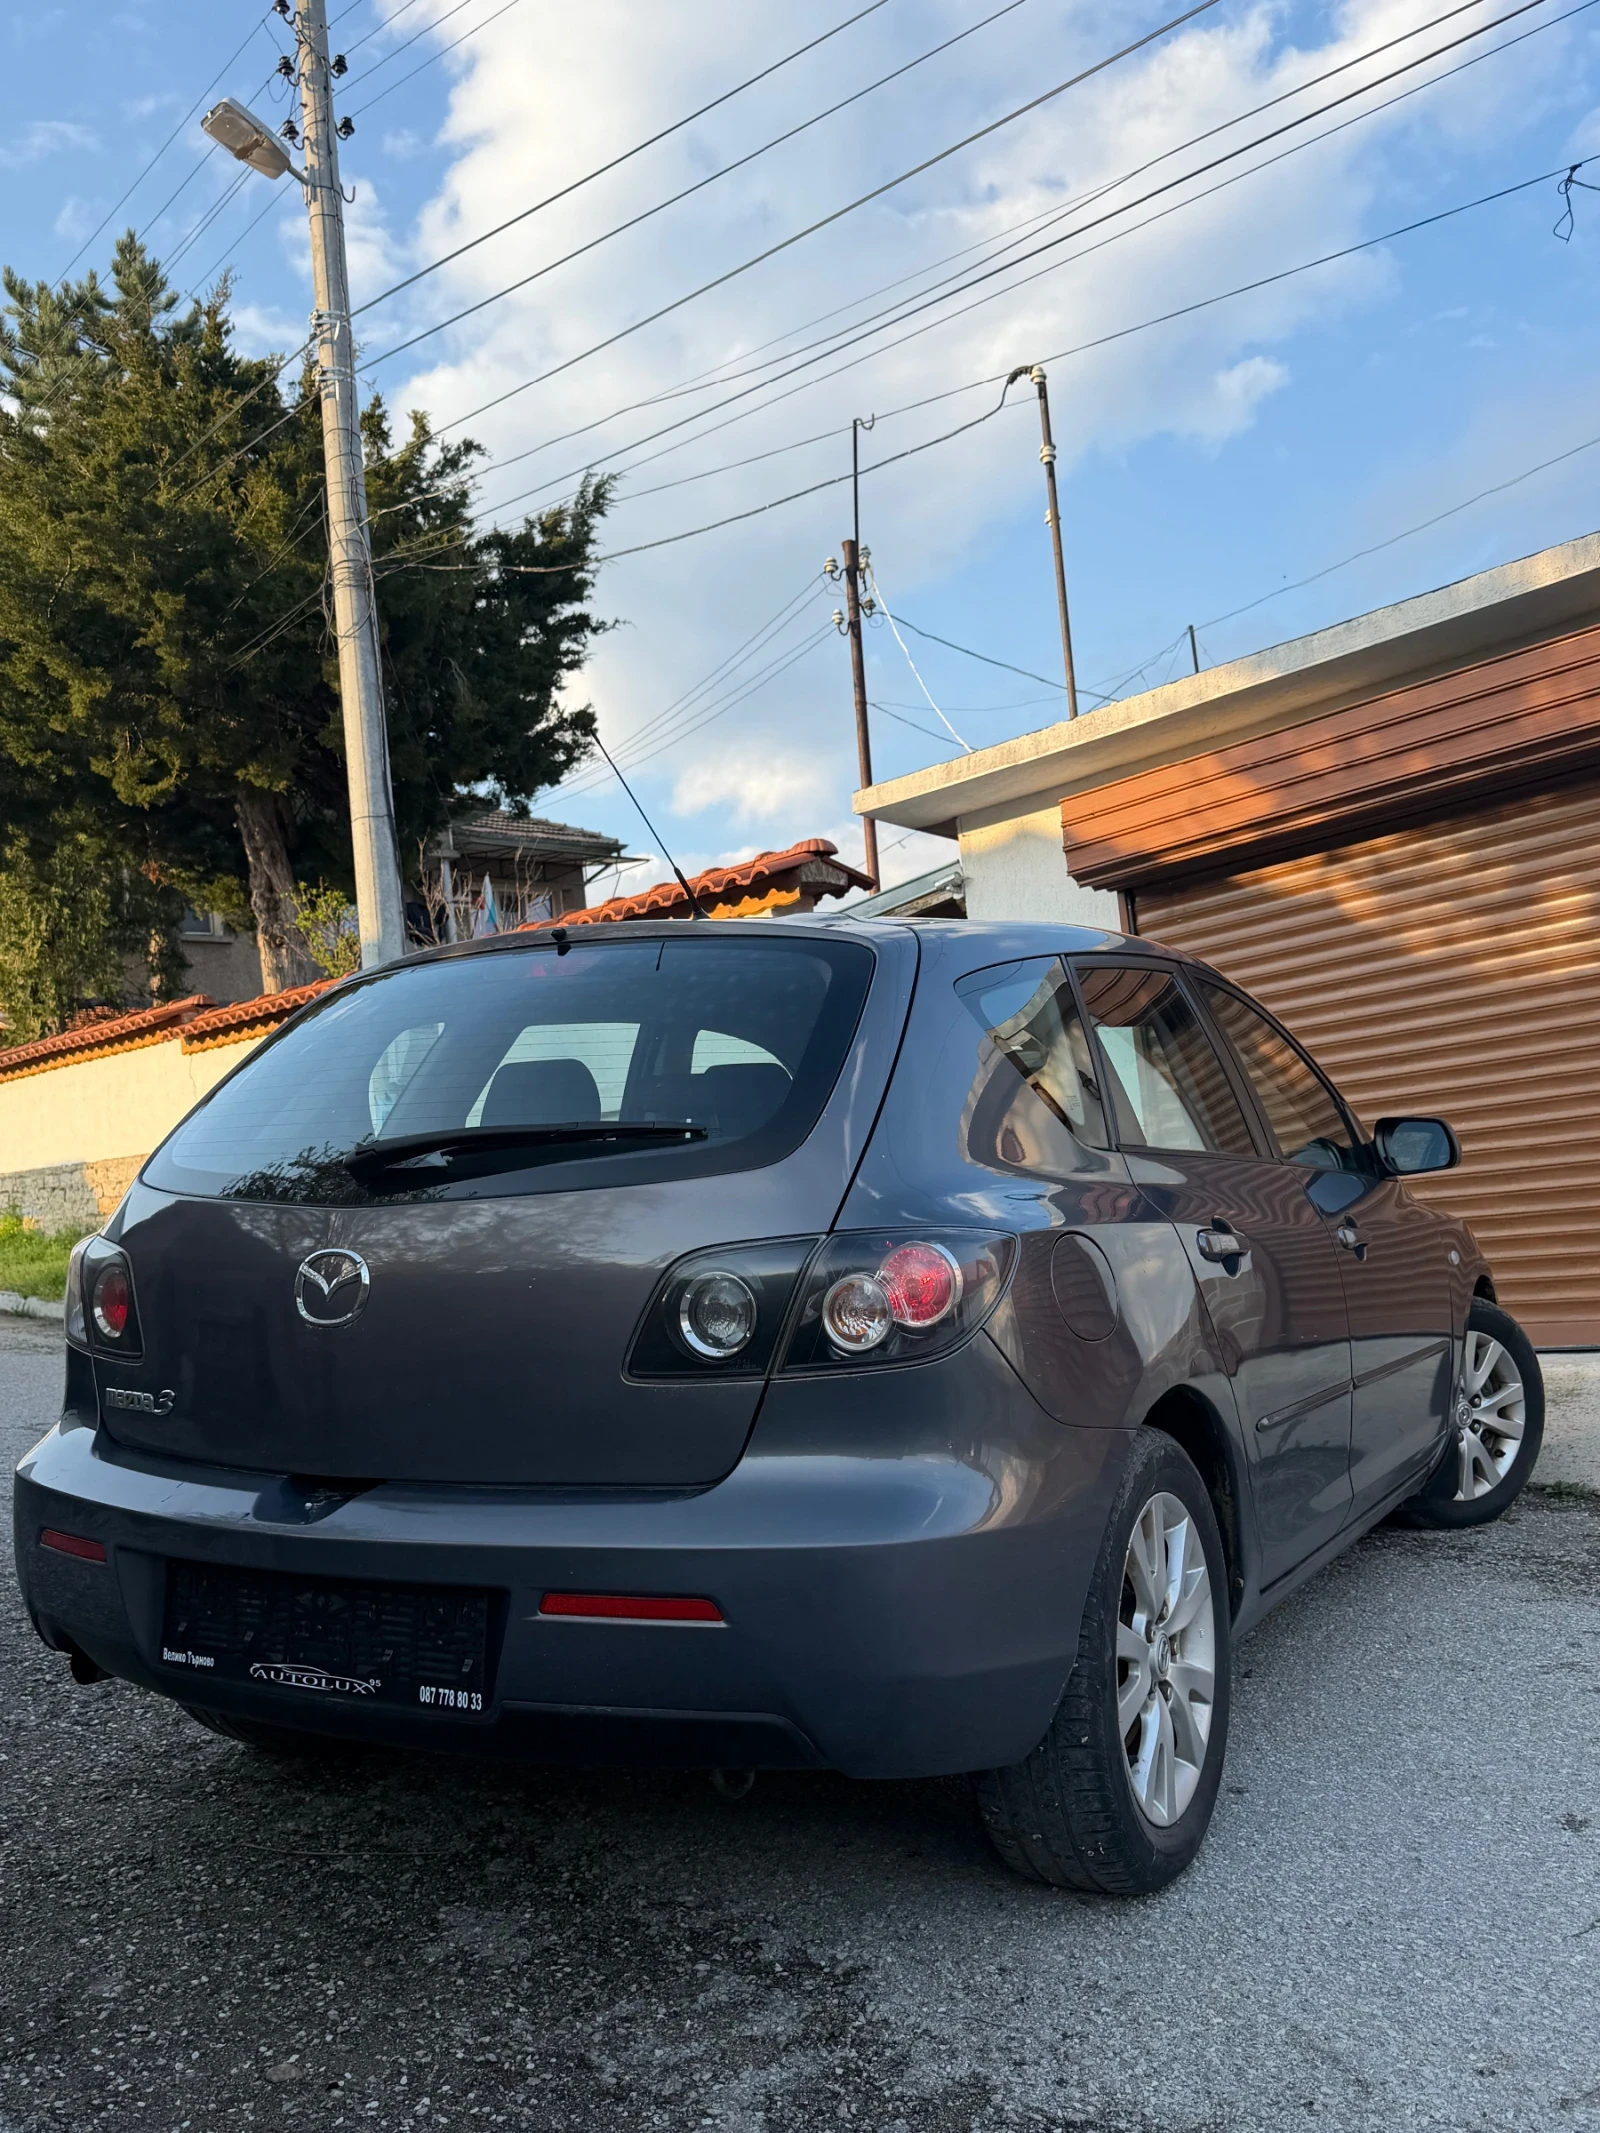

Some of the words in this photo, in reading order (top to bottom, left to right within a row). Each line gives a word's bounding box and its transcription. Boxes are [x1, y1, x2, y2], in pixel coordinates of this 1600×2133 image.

[163, 1647, 187, 1663] Велико
[187, 1651, 215, 1668] Търново
[253, 1669, 367, 1694] AUTOLUX
[419, 1685, 436, 1704] 087
[438, 1688, 455, 1706] 778
[457, 1690, 468, 1708] 80
[470, 1692, 482, 1711] 33
